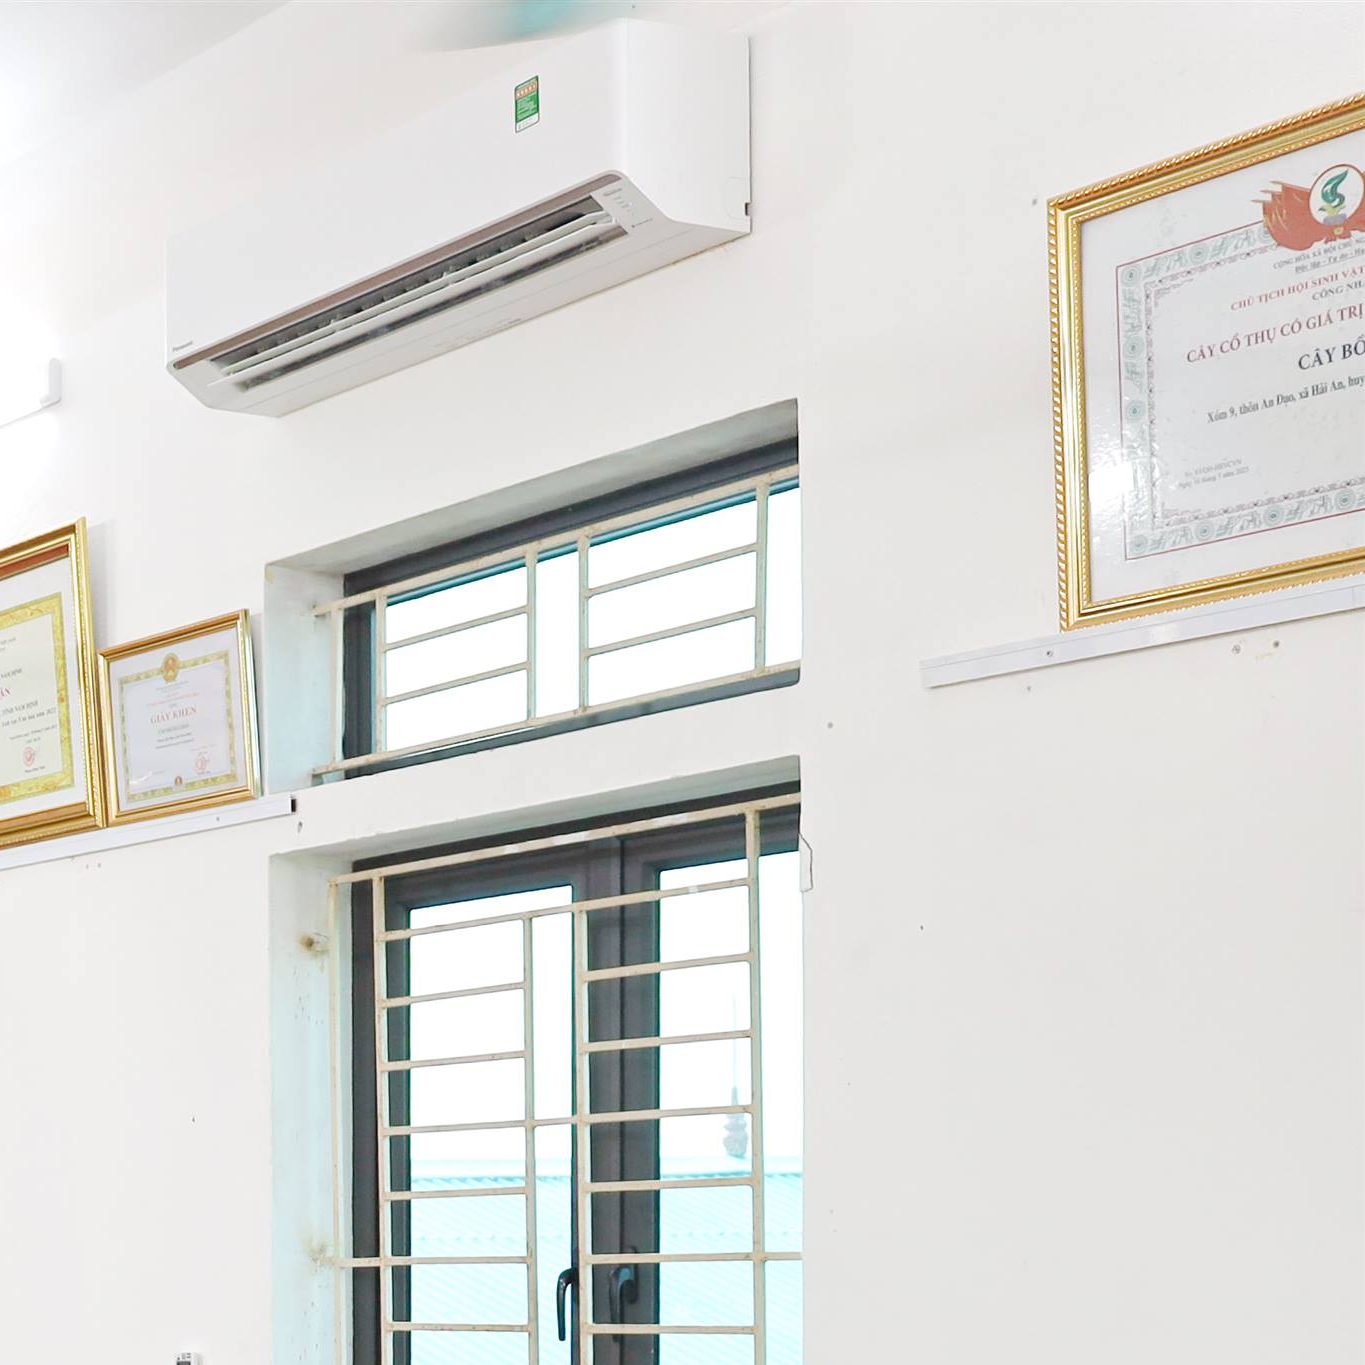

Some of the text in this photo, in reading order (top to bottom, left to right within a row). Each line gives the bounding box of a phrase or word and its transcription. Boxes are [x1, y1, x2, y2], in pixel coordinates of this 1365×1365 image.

[1258, 287, 1285, 304] TỊCH
[1288, 280, 1308, 295] HỘI
[1312, 273, 1339, 288] SINH
[1312, 284, 1344, 301] CÔNG
[1244, 327, 1276, 348] THỤ
[1280, 318, 1302, 337] CÓ
[1306, 308, 1333, 330] GIÁ
[1336, 303, 1364, 322] TRỊ
[1298, 346, 1336, 370] CÂY
